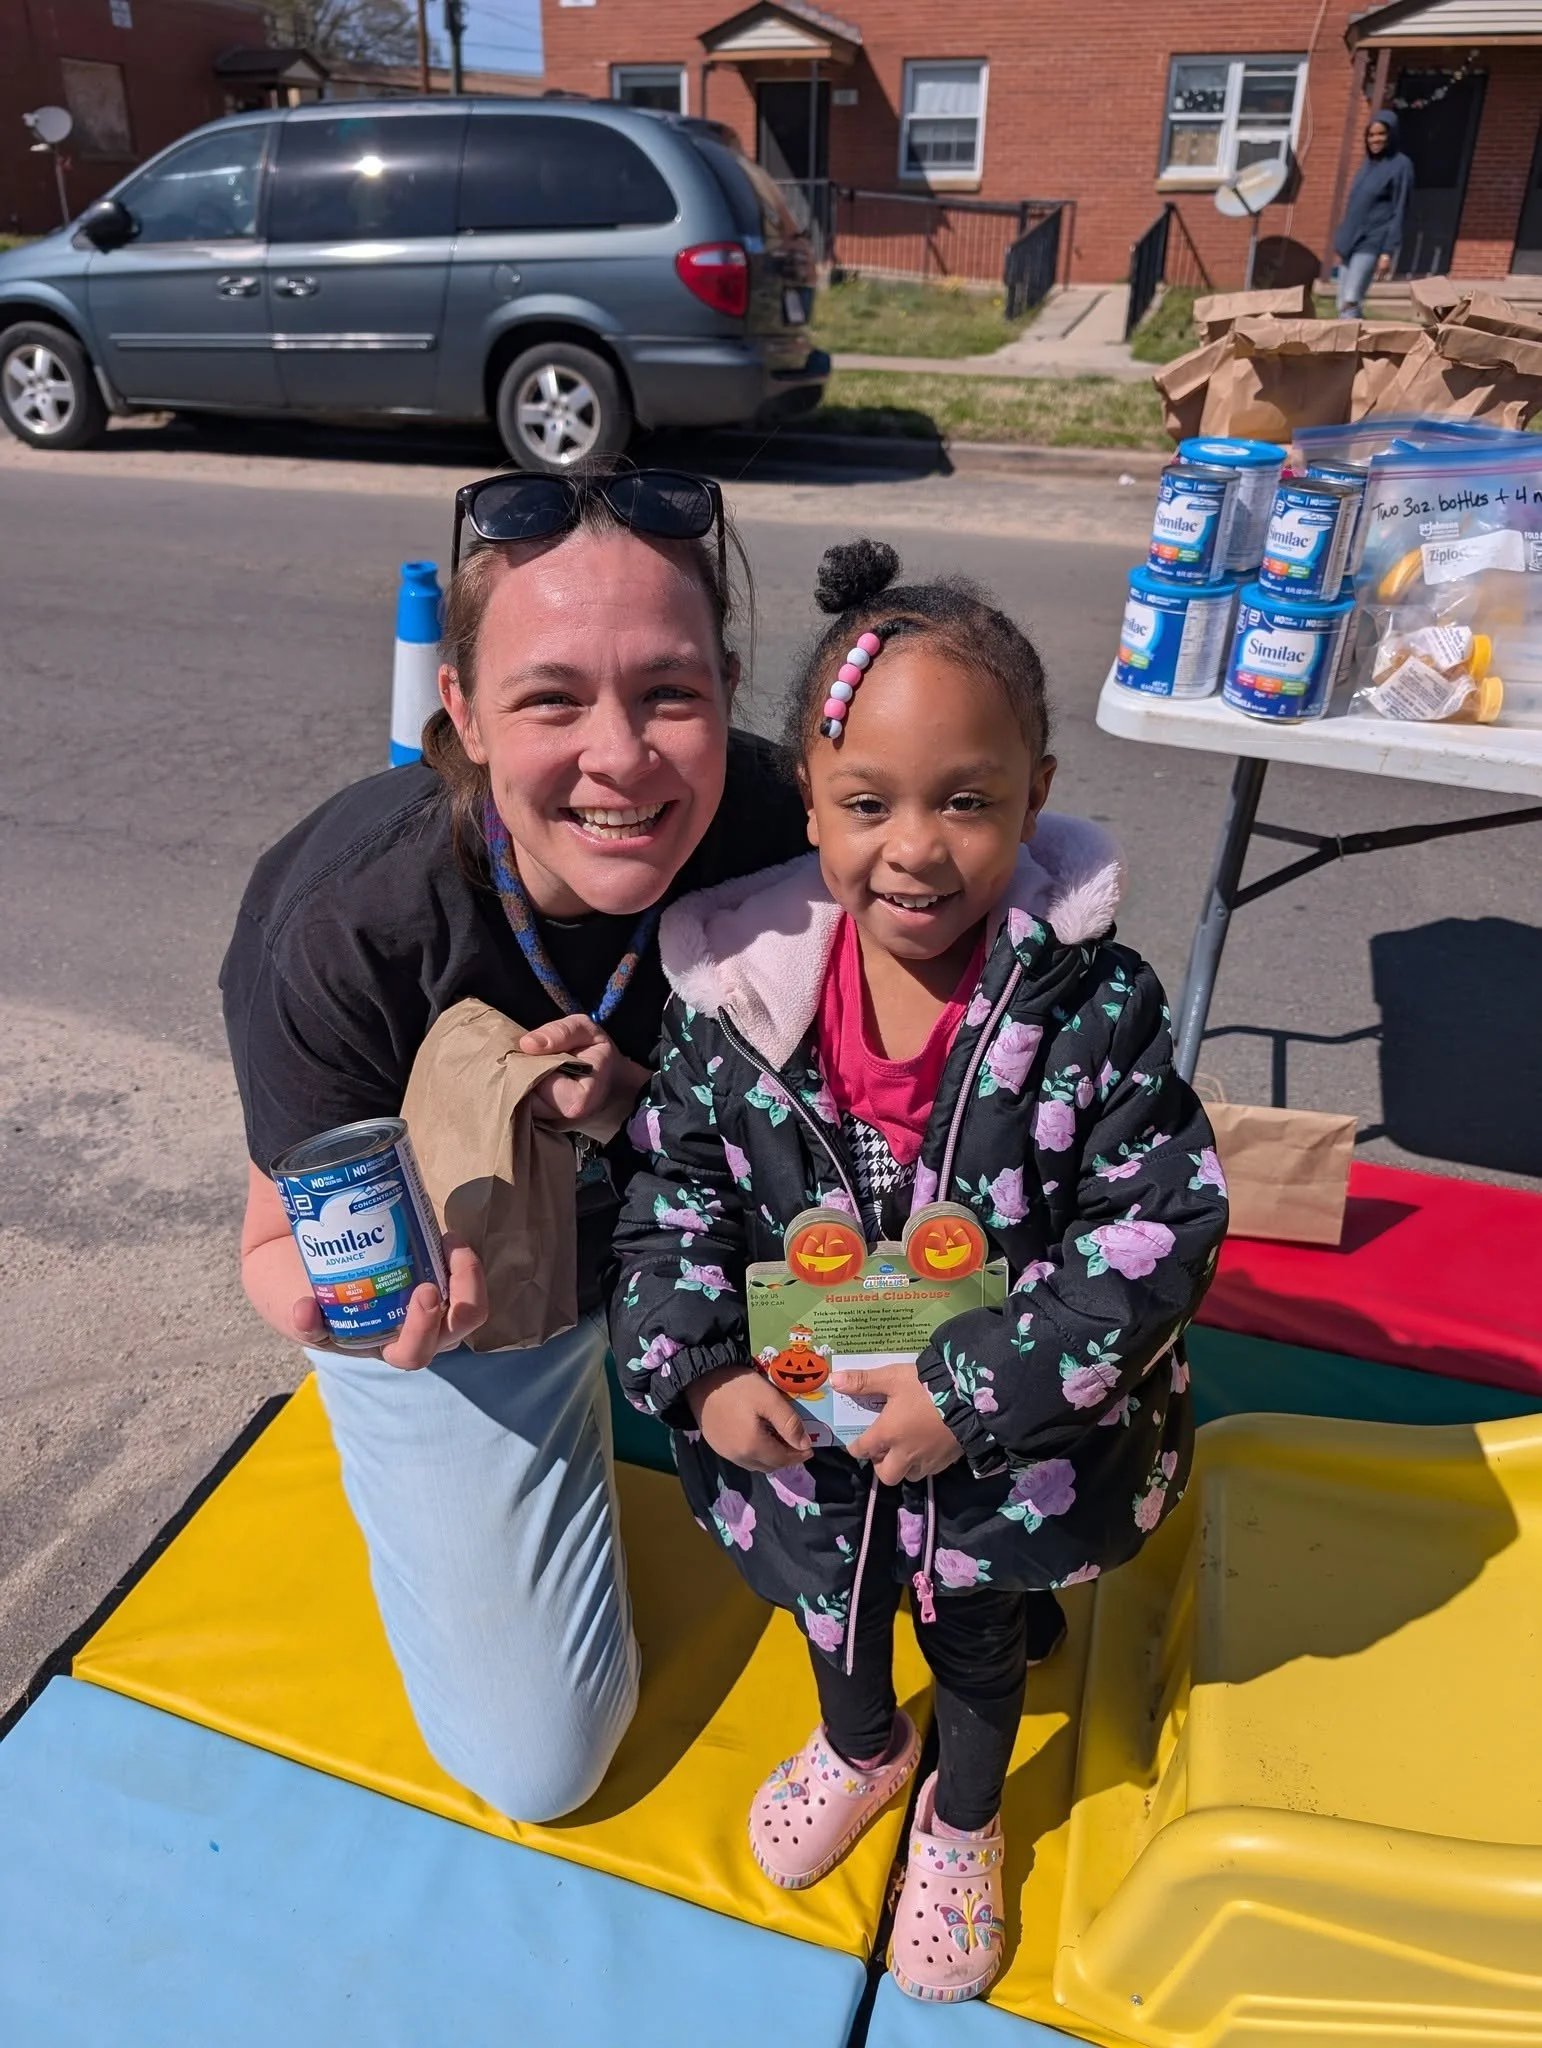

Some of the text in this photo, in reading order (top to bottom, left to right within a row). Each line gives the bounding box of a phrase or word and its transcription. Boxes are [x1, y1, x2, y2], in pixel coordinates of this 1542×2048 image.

[1371, 502, 1400, 521] Two
[1438, 489, 1489, 512] bottles
[1515, 485, 1527, 505] 4
[1248, 638, 1306, 663] Similac
[352, 1164, 367, 1178] NO
[311, 1177, 325, 1189] NO
[353, 1185, 403, 1210] CONCENTRATED
[302, 1224, 385, 1258] Similac
[325, 1251, 366, 1266] ADVANCE
[375, 1273, 408, 1290] DEVELOPMENT
[377, 1272, 396, 1282] GROWTH
[824, 1290, 951, 1304] Haunted Clubhouse
[387, 1307, 405, 1320] 13 FL
[329, 1319, 360, 1329] FORMULA
[855, 1323, 886, 1331] hauntingly
[892, 1329, 905, 1337] they
